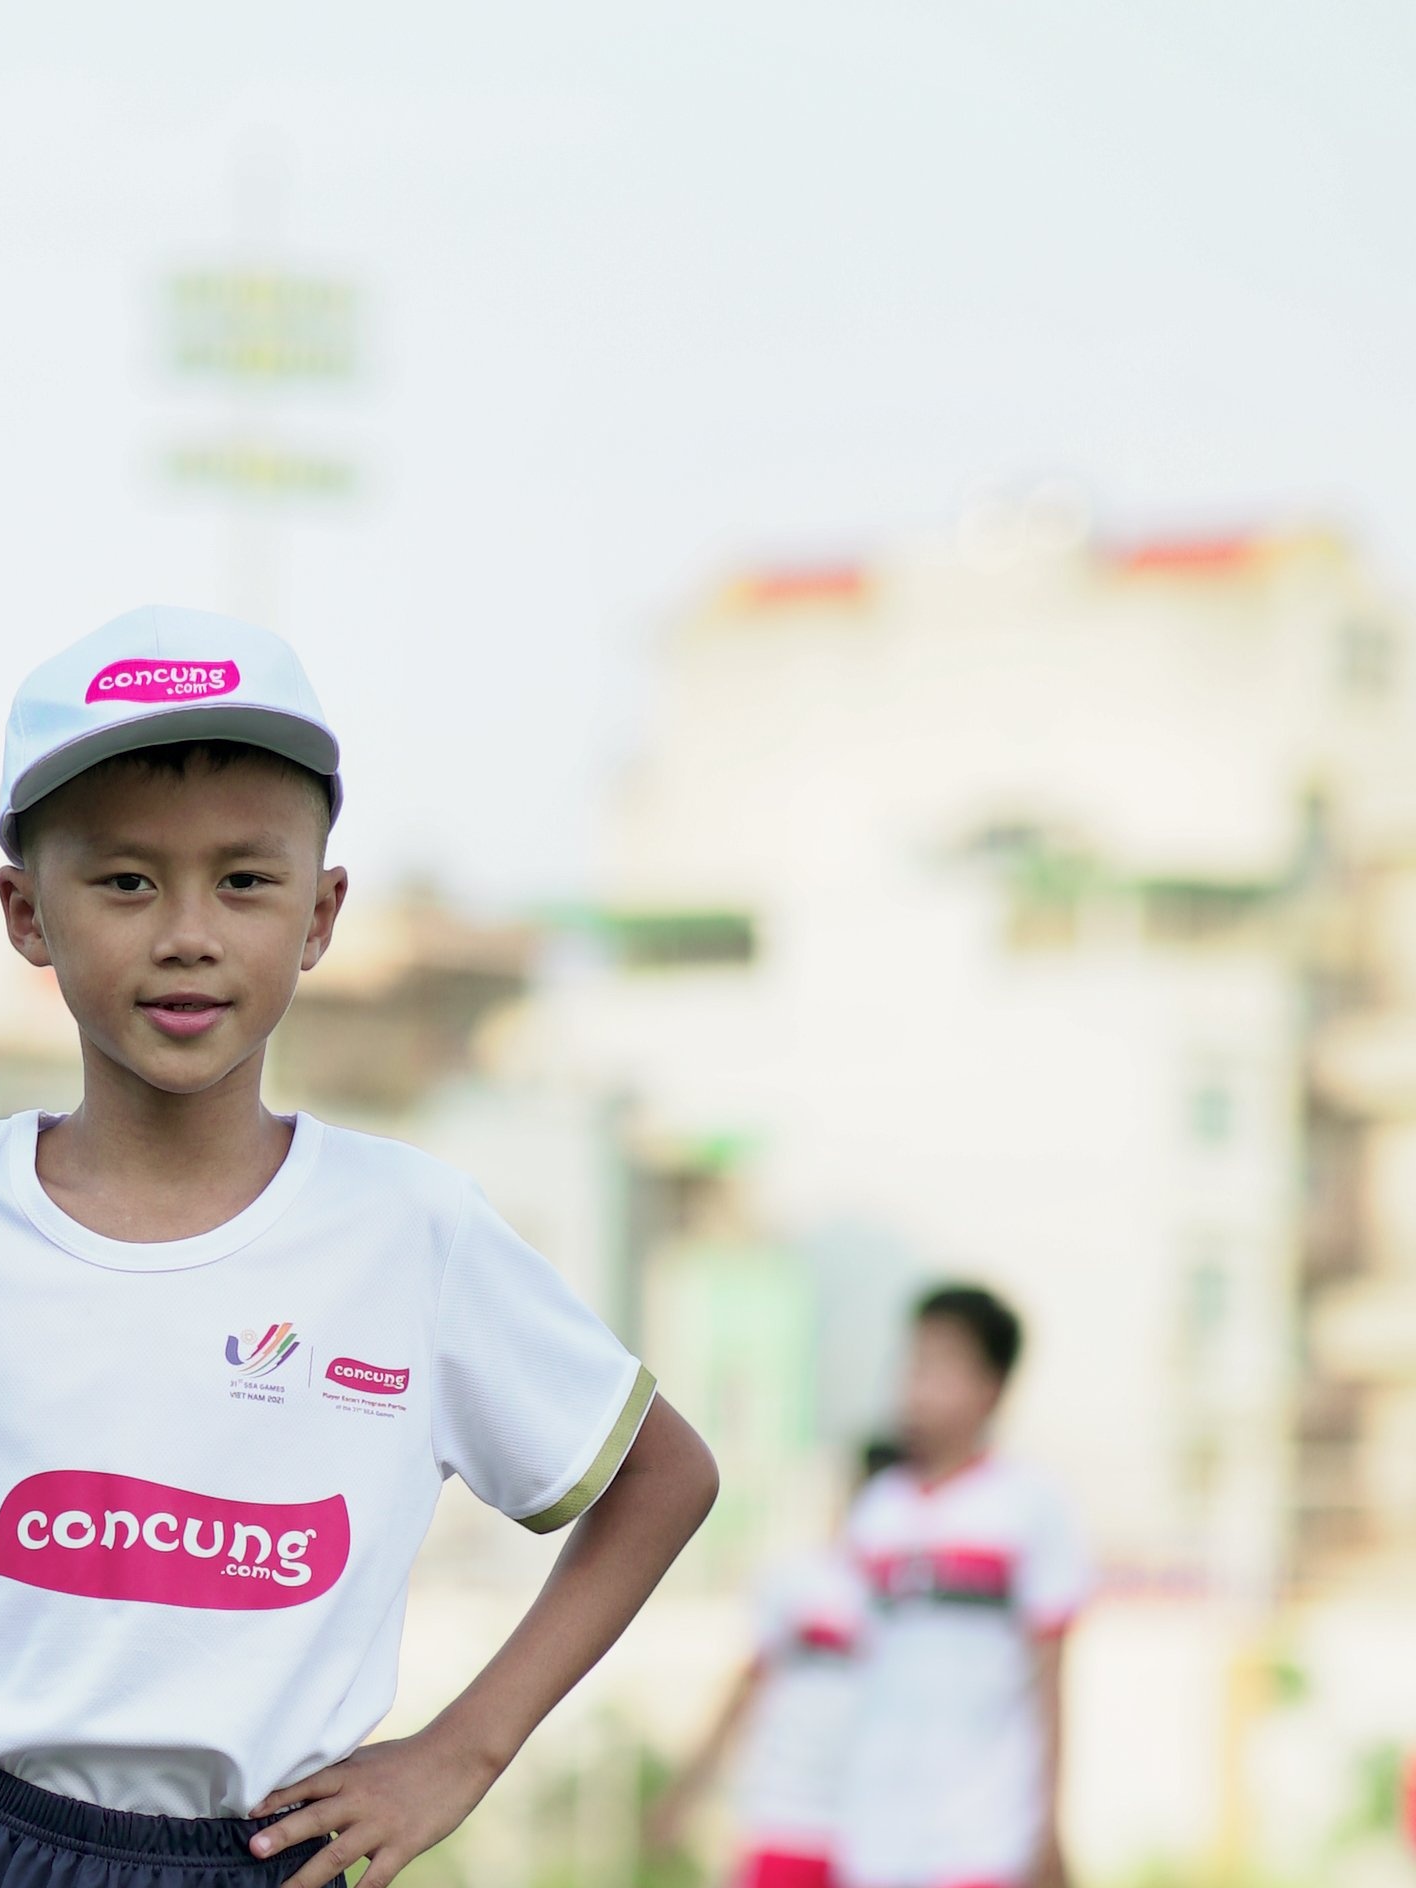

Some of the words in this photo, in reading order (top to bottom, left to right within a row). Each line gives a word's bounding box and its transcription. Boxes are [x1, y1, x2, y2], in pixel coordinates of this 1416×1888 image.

[98, 667, 226, 689] concung
[166, 682, 208, 695] .com
[334, 1365, 406, 1390] concung
[17, 1509, 317, 1587] concung
[220, 1563, 271, 1580] .com
